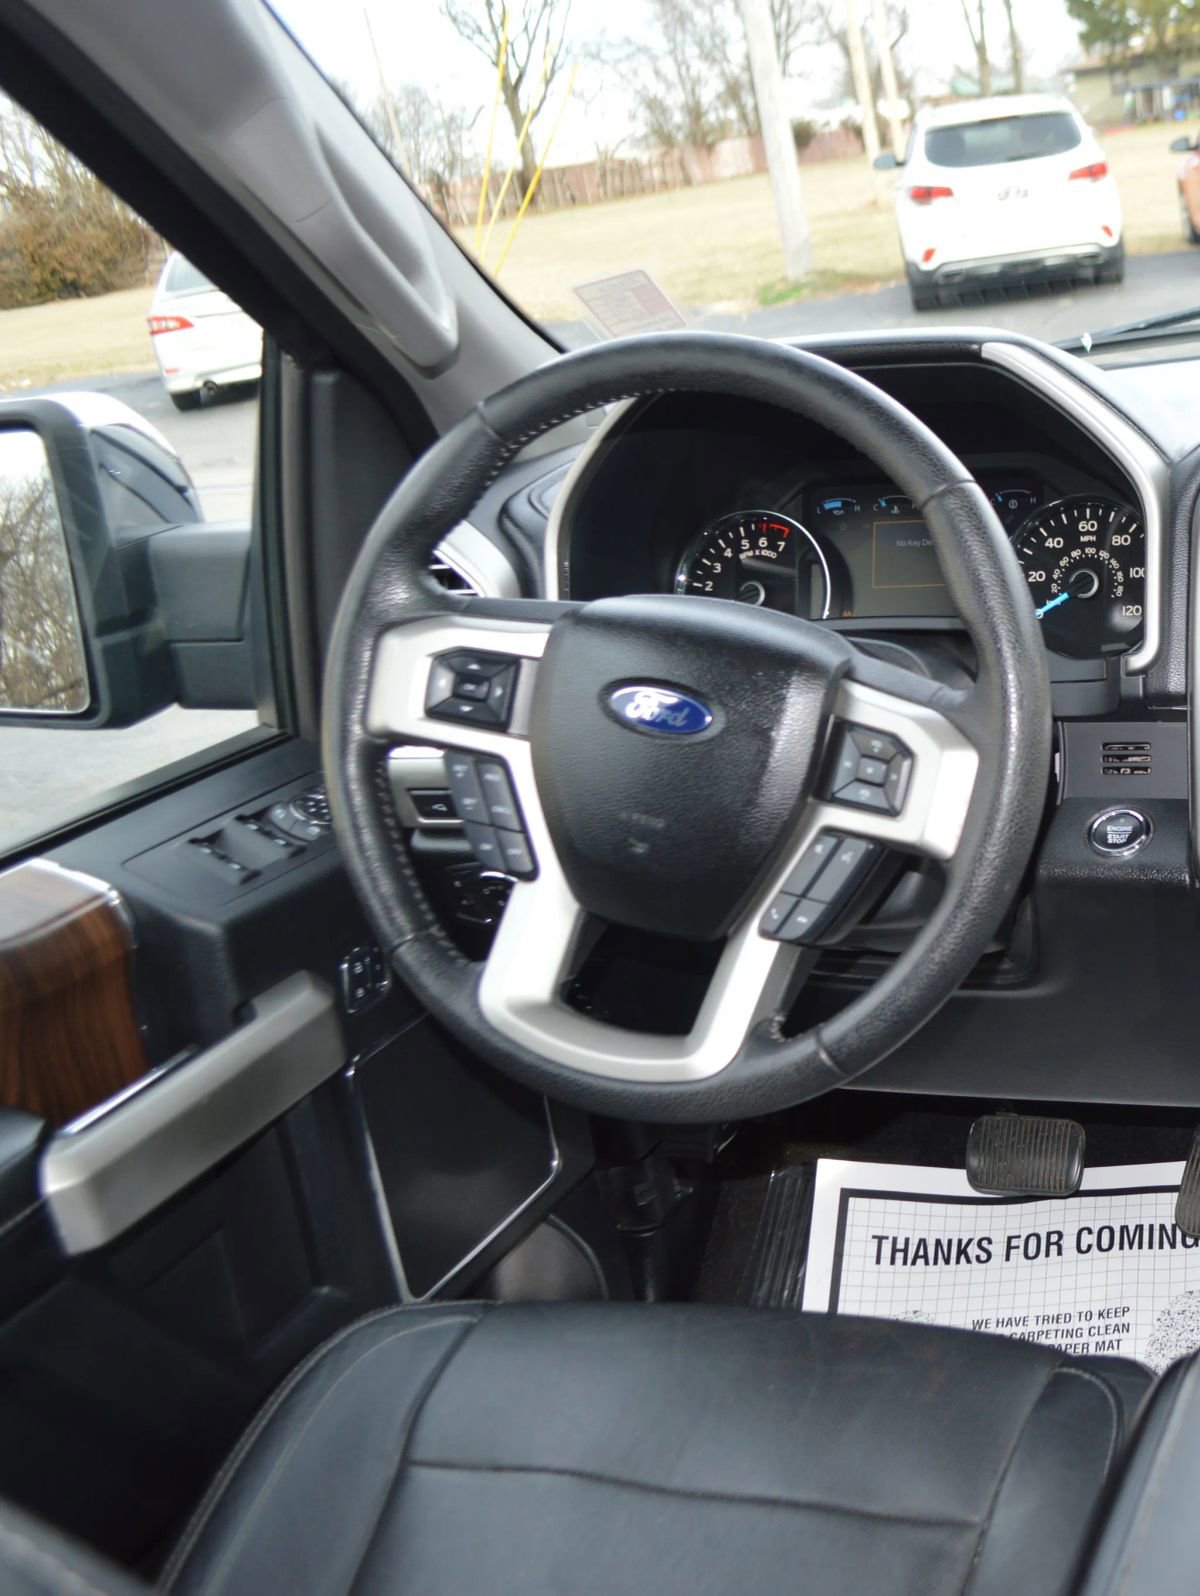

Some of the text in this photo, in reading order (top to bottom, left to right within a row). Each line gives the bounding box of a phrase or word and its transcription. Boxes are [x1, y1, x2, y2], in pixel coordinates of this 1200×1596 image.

[1078, 521, 1098, 532] 60
[741, 538, 750, 550] 5
[758, 537, 768, 548] 6
[896, 539, 907, 548] No
[908, 539, 921, 550] Key
[1044, 537, 1064, 548] 40
[1111, 535, 1131, 546] 80
[777, 541, 786, 552] 7
[723, 547, 733, 559] 4
[713, 563, 722, 574] 3
[1028, 571, 1046, 582] 20
[704, 581, 713, 592] 2
[1122, 605, 1142, 616] 120
[625, 690, 690, 727] Ford
[871, 1234, 993, 1266] THANKS
[1004, 1230, 1064, 1262] FOR
[972, 1306, 1130, 1330] WE HAVE TRIED TO KEEP
[1088, 1322, 1130, 1337] CLEAN
[1095, 1338, 1123, 1353] MAT
